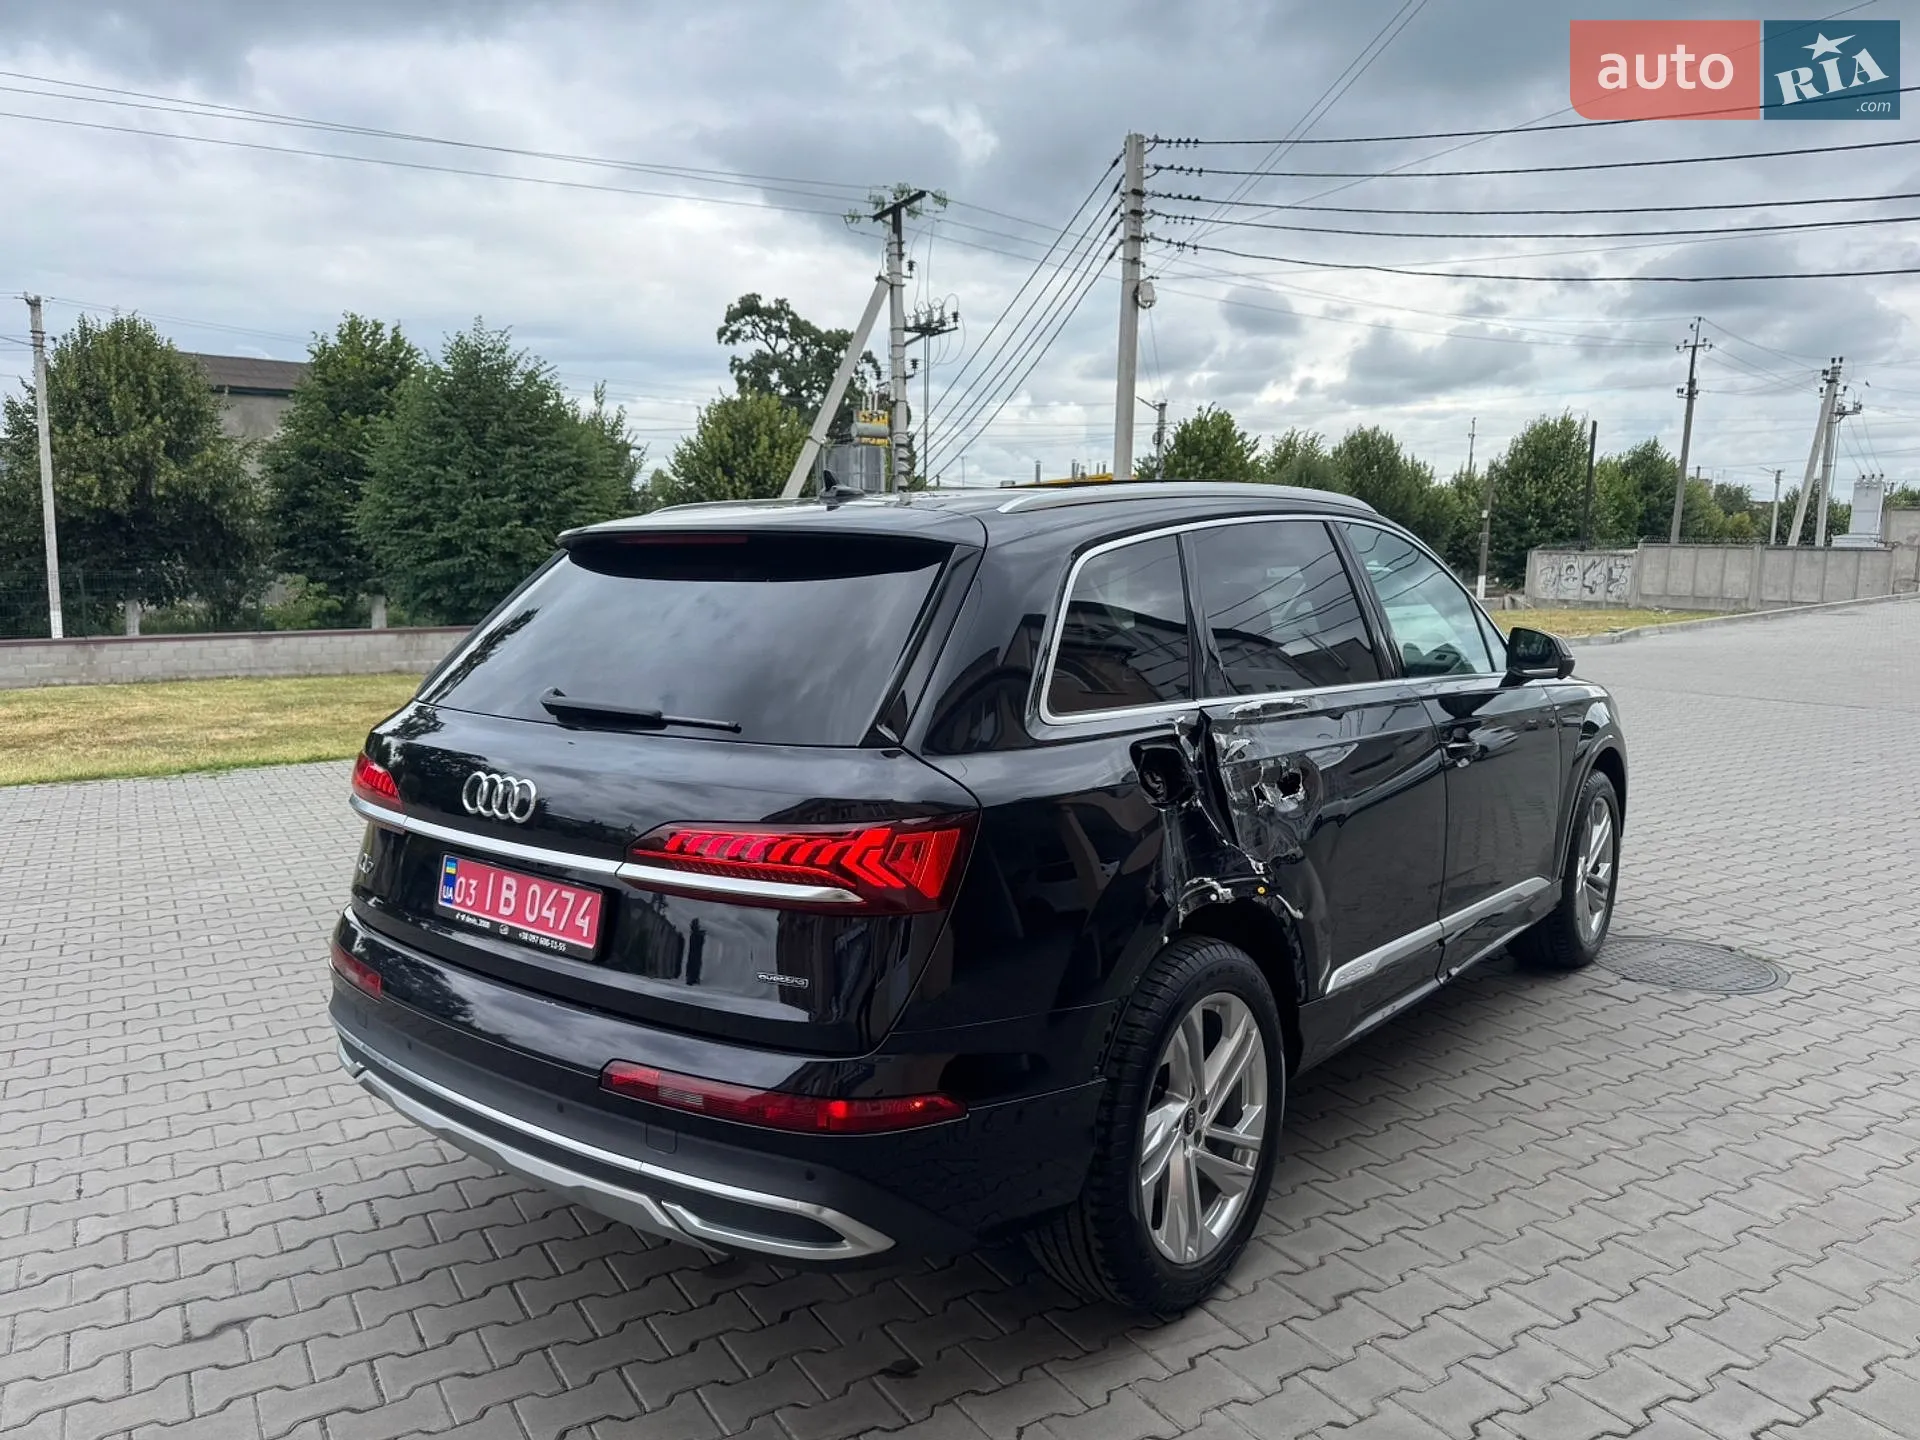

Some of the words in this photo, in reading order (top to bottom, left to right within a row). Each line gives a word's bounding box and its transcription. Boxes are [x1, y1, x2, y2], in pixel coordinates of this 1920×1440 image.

[442, 884, 454, 900] UA
[454, 876, 479, 907] 03
[485, 872, 517, 916] IB
[525, 883, 594, 938] 0474
